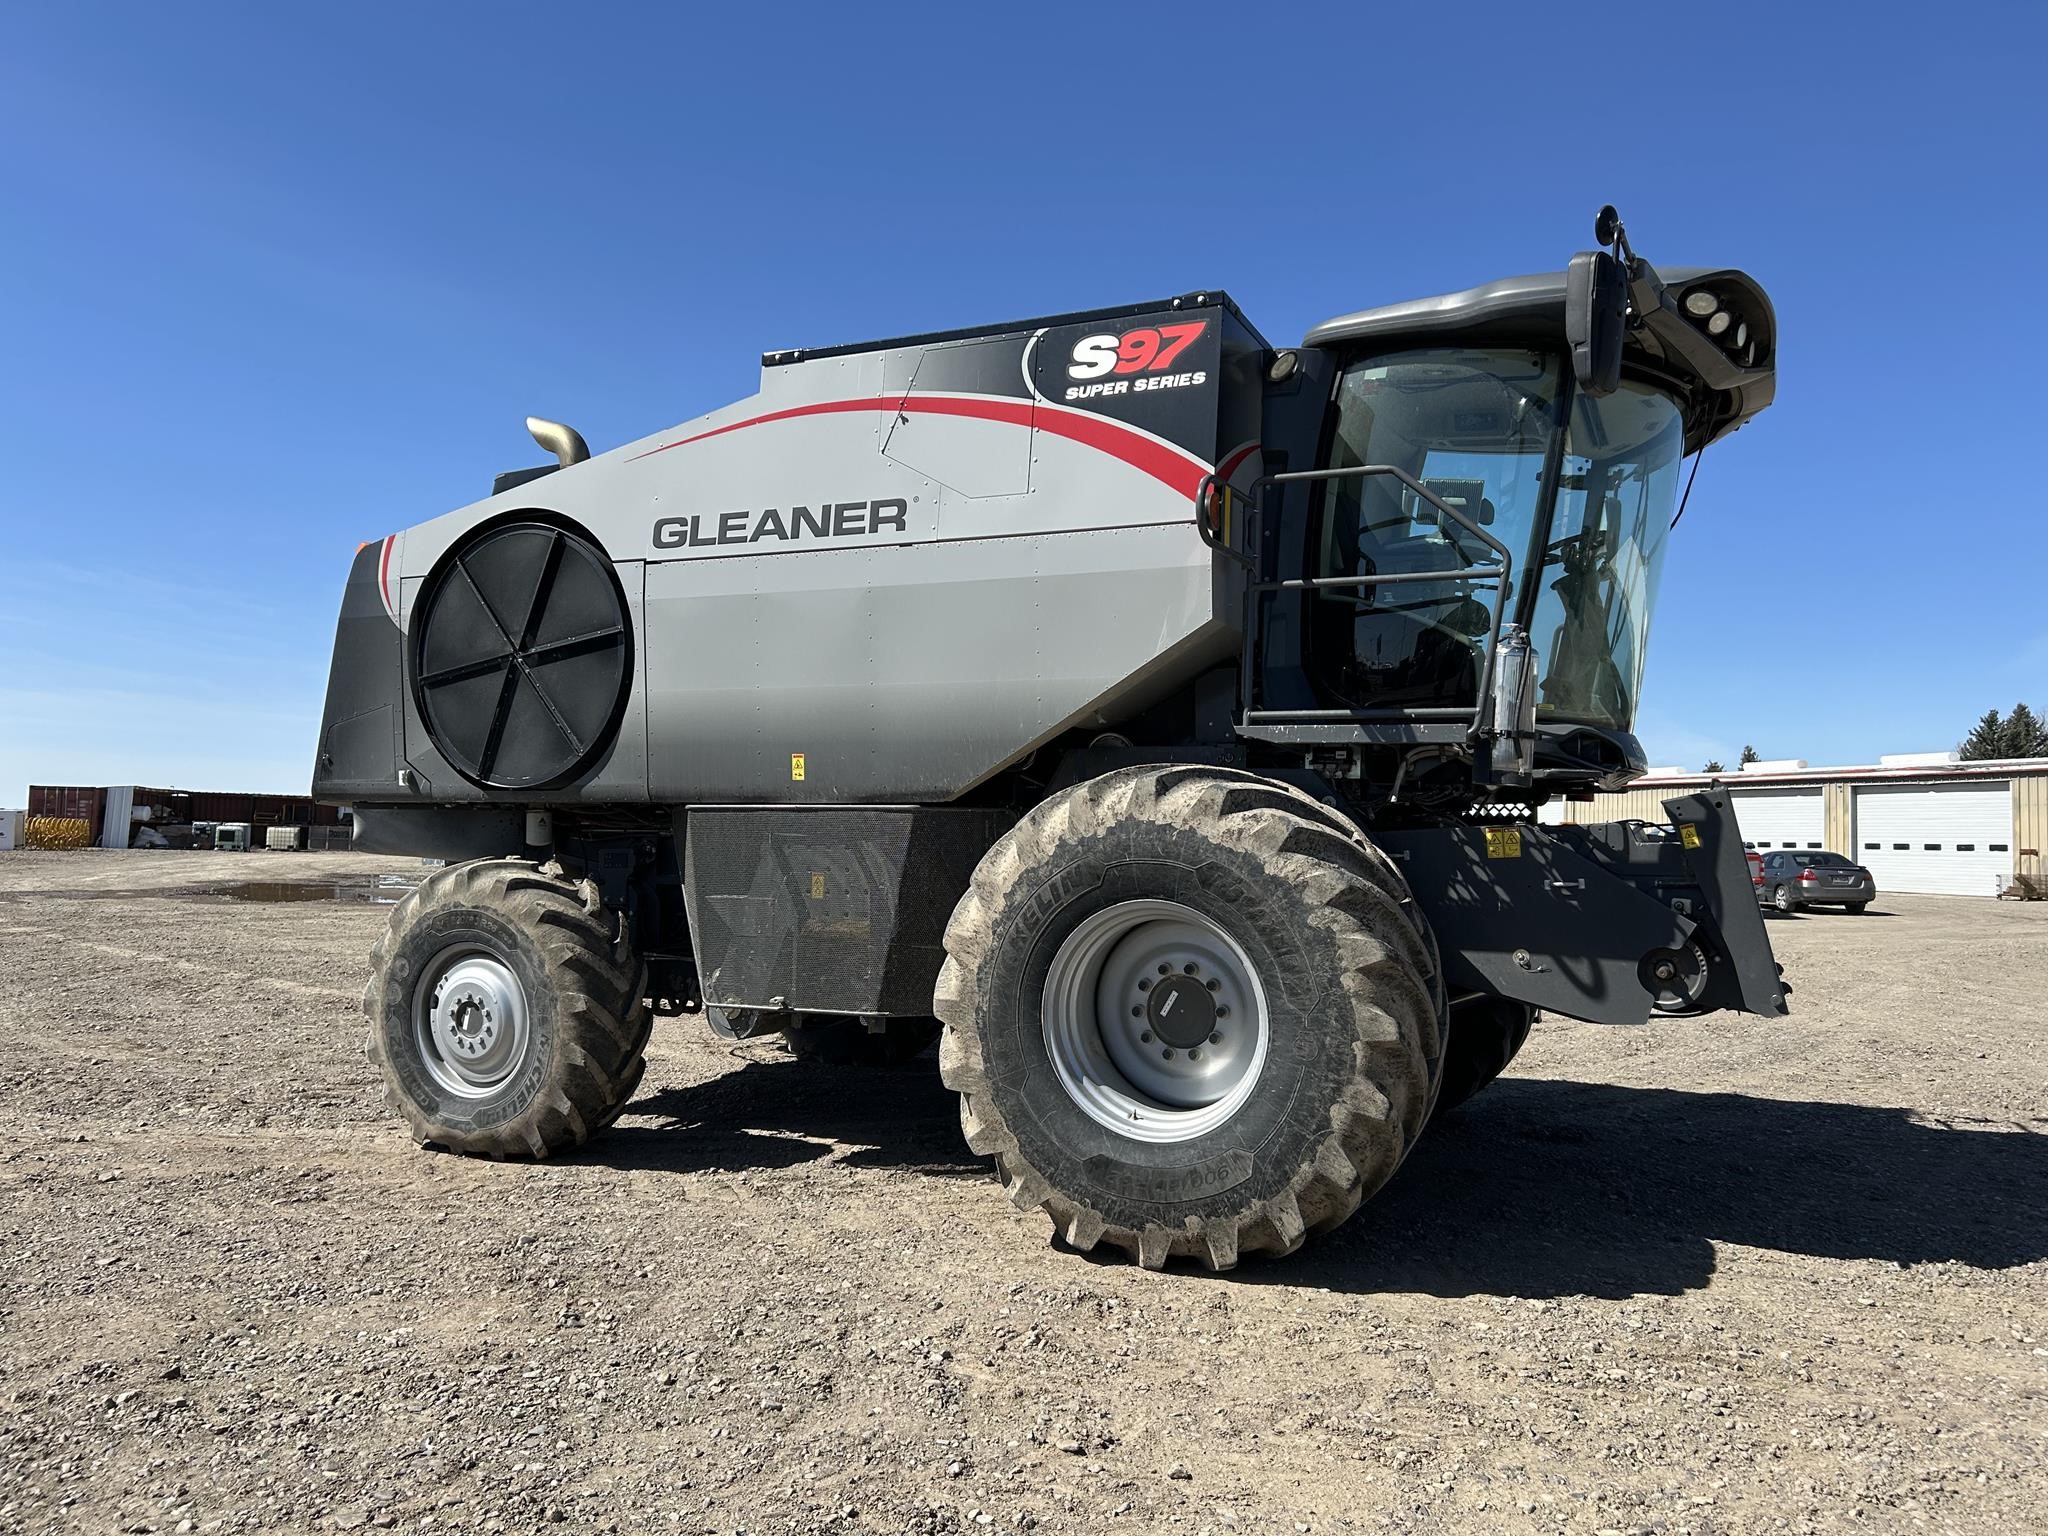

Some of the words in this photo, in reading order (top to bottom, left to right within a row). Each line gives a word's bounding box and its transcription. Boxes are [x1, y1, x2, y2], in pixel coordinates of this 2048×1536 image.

[1068, 321, 1207, 380] S97
[1065, 380, 1129, 400] SUPER
[1133, 371, 1207, 393] SERIES
[652, 497, 908, 550] GLEANER
